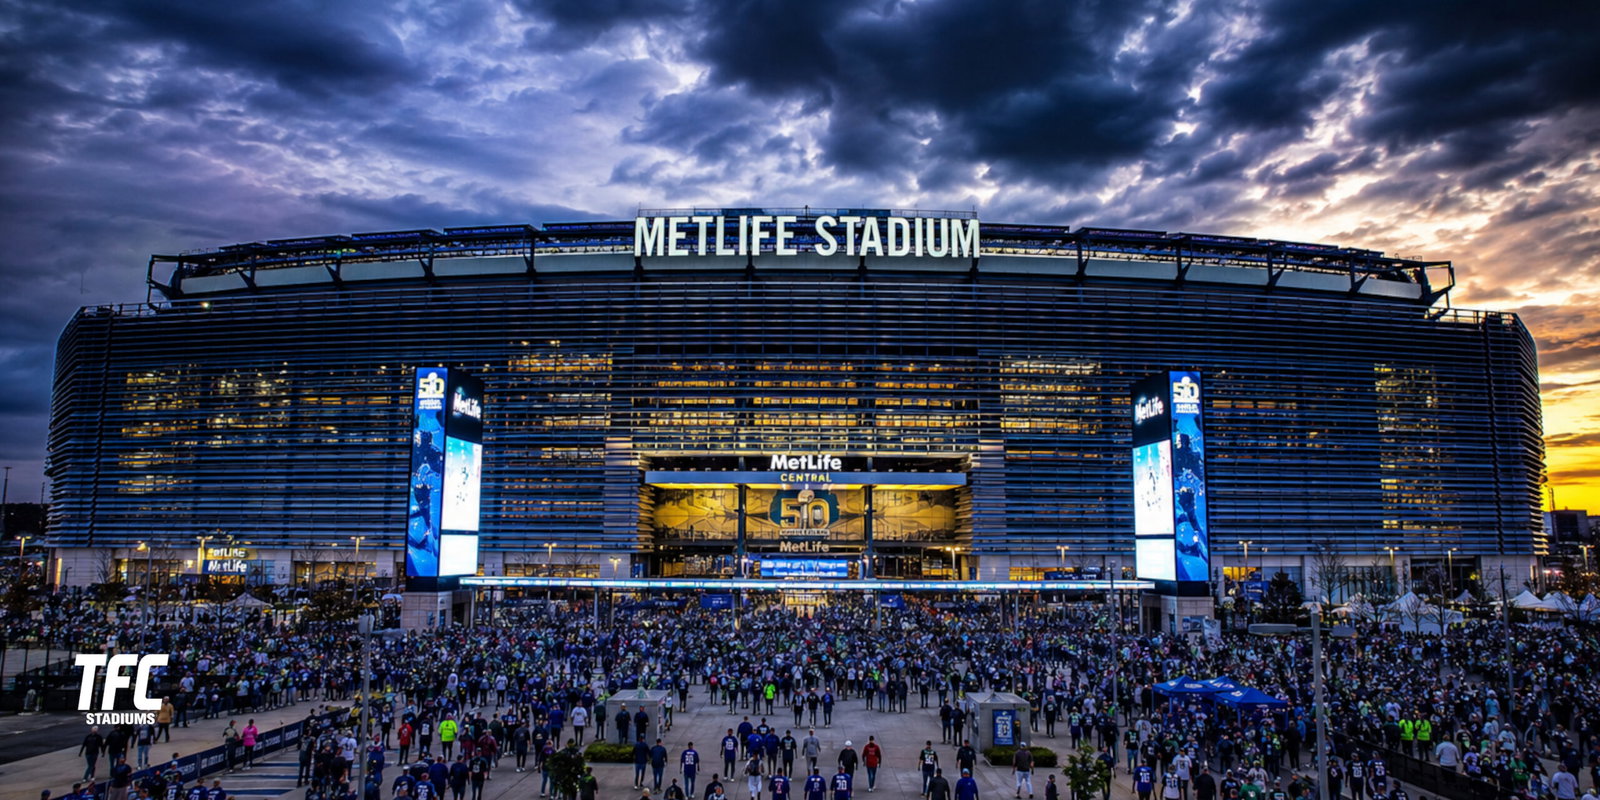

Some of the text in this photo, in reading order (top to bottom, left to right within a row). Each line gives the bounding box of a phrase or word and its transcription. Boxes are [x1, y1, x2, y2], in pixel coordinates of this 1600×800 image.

[634, 215, 980, 259] METLIFE STADIUM
[418, 377, 445, 395] 50
[453, 392, 482, 419] MetLife
[1135, 396, 1164, 421] MetLife
[770, 454, 842, 471] MetLife
[780, 472, 832, 482] CENTRAL
[780, 497, 830, 529] 50
[779, 541, 830, 553] MetLife
